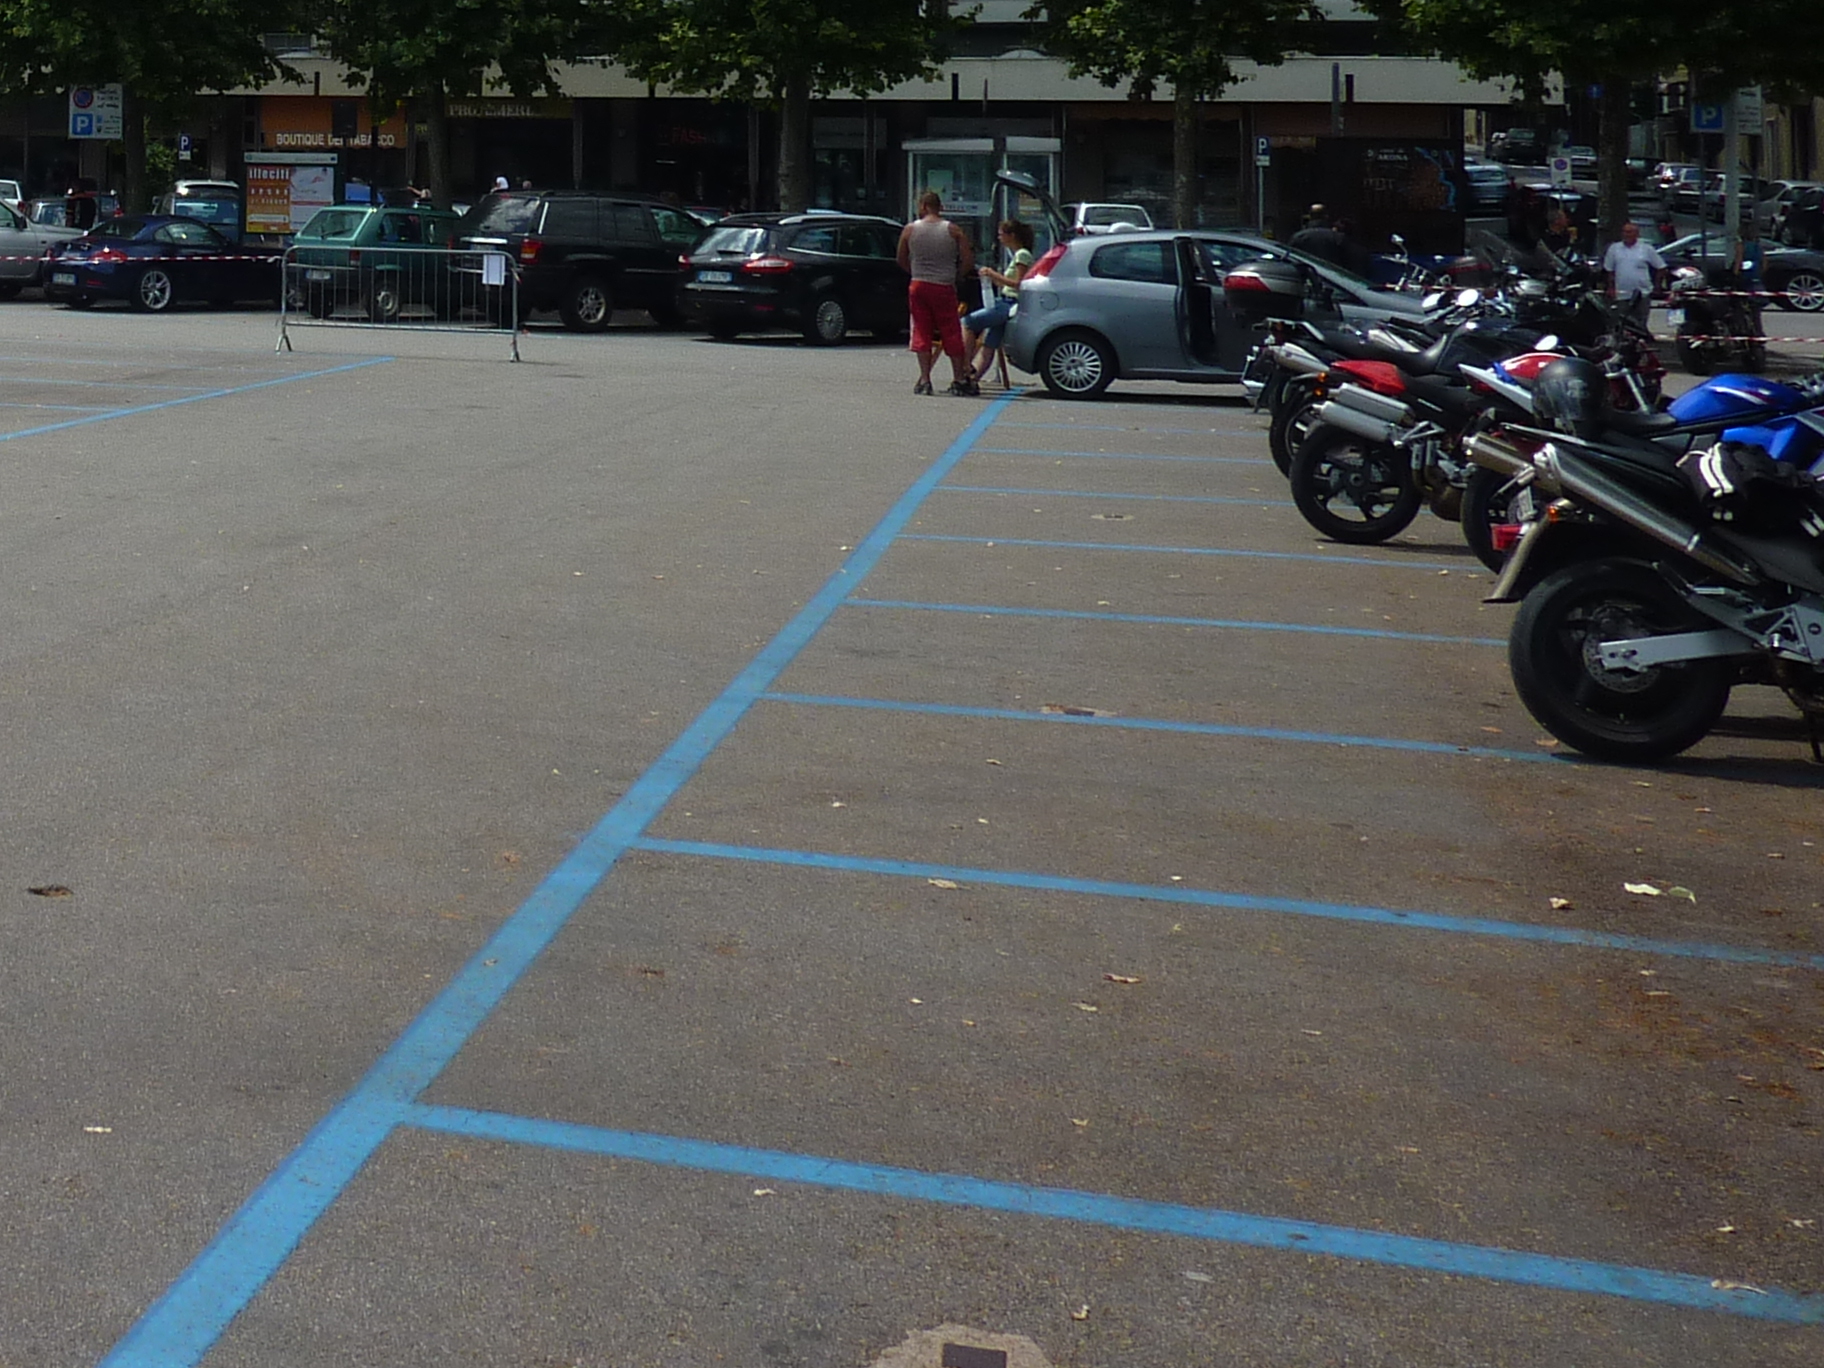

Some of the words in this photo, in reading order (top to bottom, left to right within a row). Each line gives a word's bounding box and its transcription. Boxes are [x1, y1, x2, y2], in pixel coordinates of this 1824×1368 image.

[1701, 106, 1717, 125] P
[77, 116, 89, 133] P
[181, 136, 189, 150] P
[276, 133, 325, 146] BOUTIQUE
[1258, 138, 1267, 153] P
